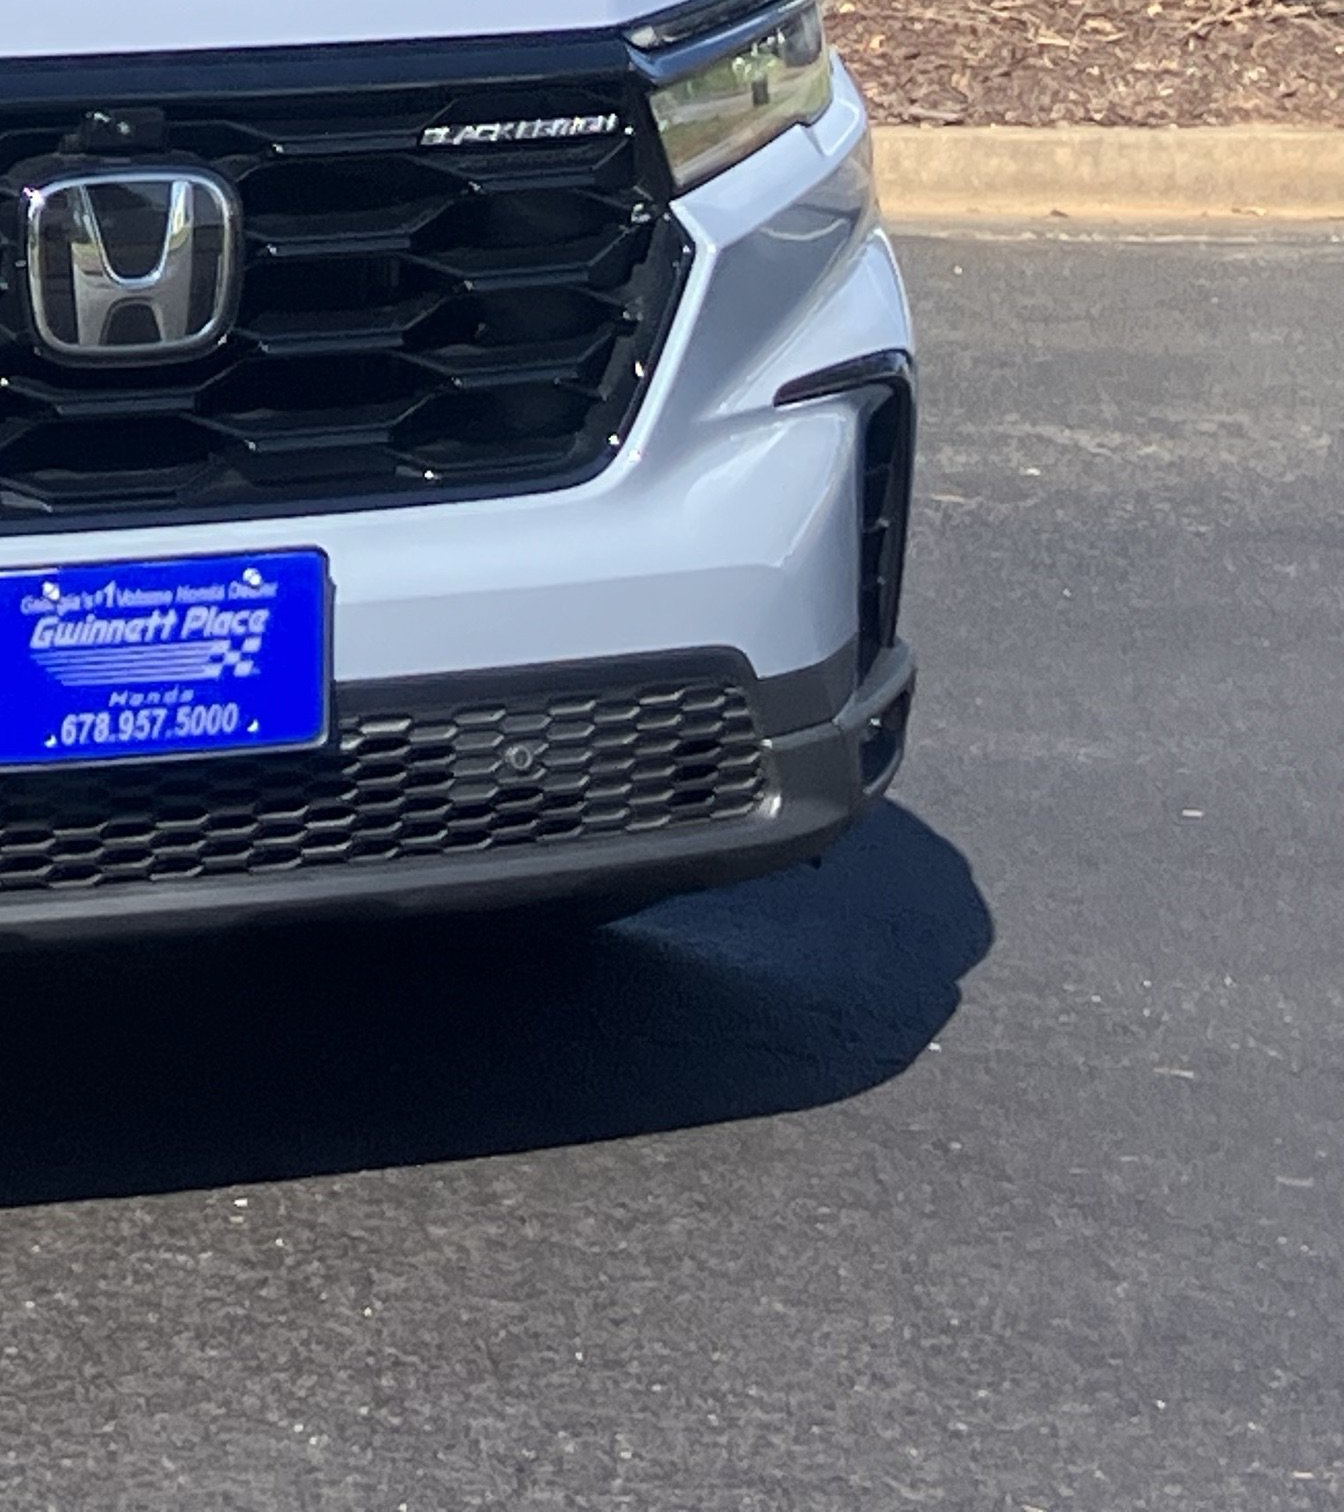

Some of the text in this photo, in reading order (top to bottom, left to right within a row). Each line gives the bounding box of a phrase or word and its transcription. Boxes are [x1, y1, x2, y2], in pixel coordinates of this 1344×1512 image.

[30, 604, 270, 649] Gwinnett Place
[108, 685, 194, 707] Honda
[61, 702, 238, 745] 678.957.5000
